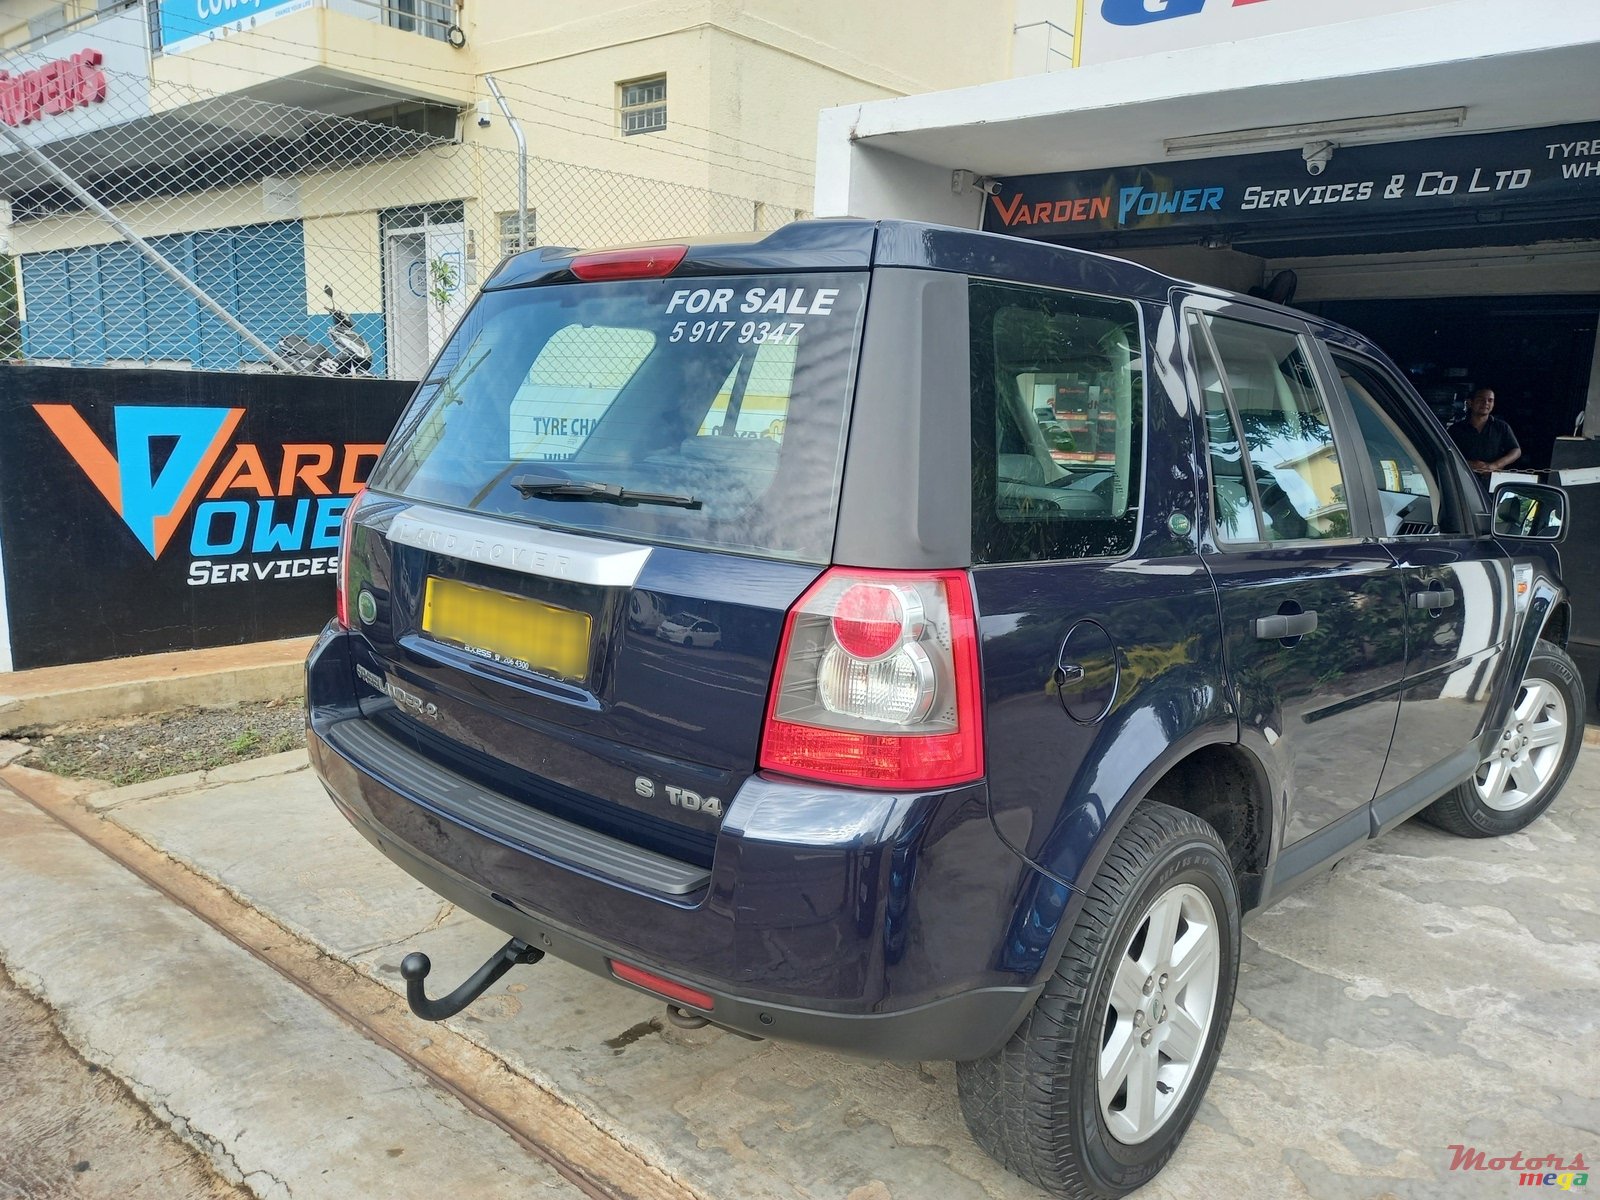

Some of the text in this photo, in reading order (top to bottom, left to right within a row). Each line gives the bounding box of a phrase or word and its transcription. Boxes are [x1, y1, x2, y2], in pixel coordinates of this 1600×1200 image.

[1545, 139, 1600, 160] TYRE
[992, 193, 1111, 226] VARDEN
[1118, 186, 1224, 225] POWER
[1240, 181, 1374, 210] SERVICES
[1383, 174, 1405, 199] &
[665, 287, 840, 316] FOR SALE
[669, 320, 804, 345] 5 917 9347
[533, 417, 568, 436] TYRE
[399, 523, 571, 576] LAND ROVER
[634, 775, 725, 818] S TD4
